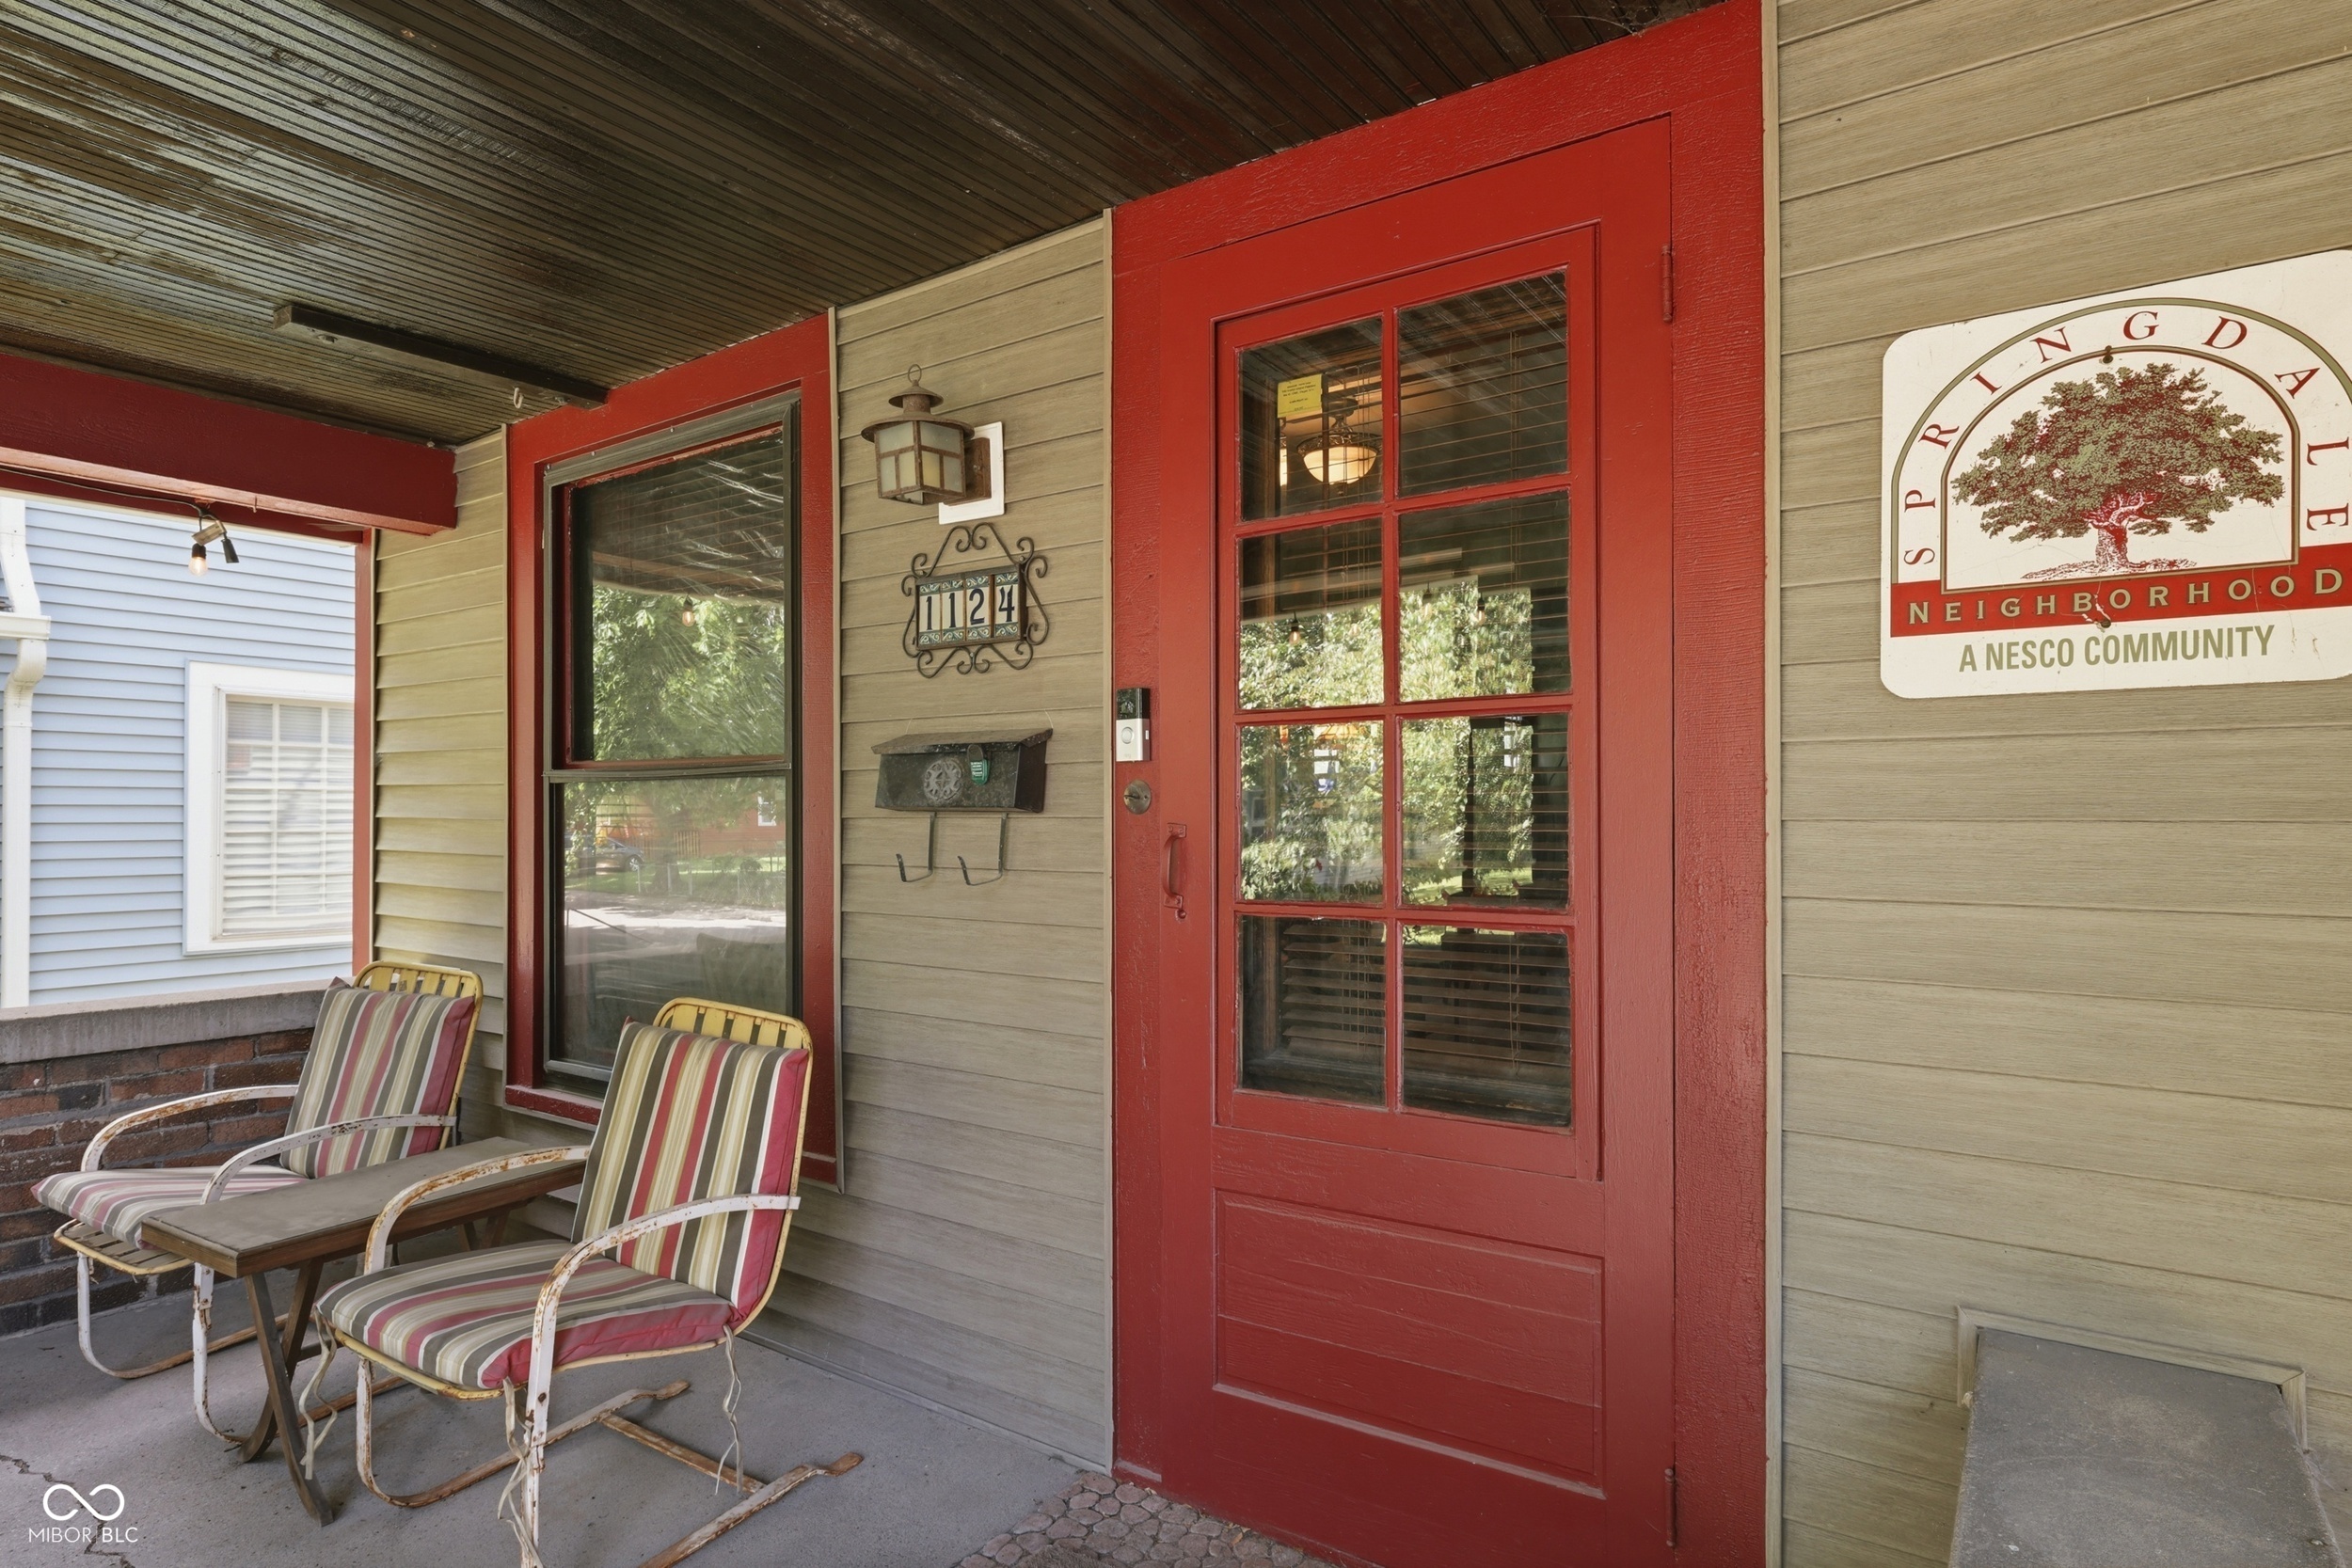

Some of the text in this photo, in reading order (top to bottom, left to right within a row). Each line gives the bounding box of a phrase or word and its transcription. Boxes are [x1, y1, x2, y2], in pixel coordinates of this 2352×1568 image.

[1904, 311, 2349, 565] SPRINGDALE
[926, 585, 1015, 631] 1124
[1909, 568, 2343, 624] NEIGHBORHOOD
[1959, 625, 2275, 672] A NESCO COMMUNITY
